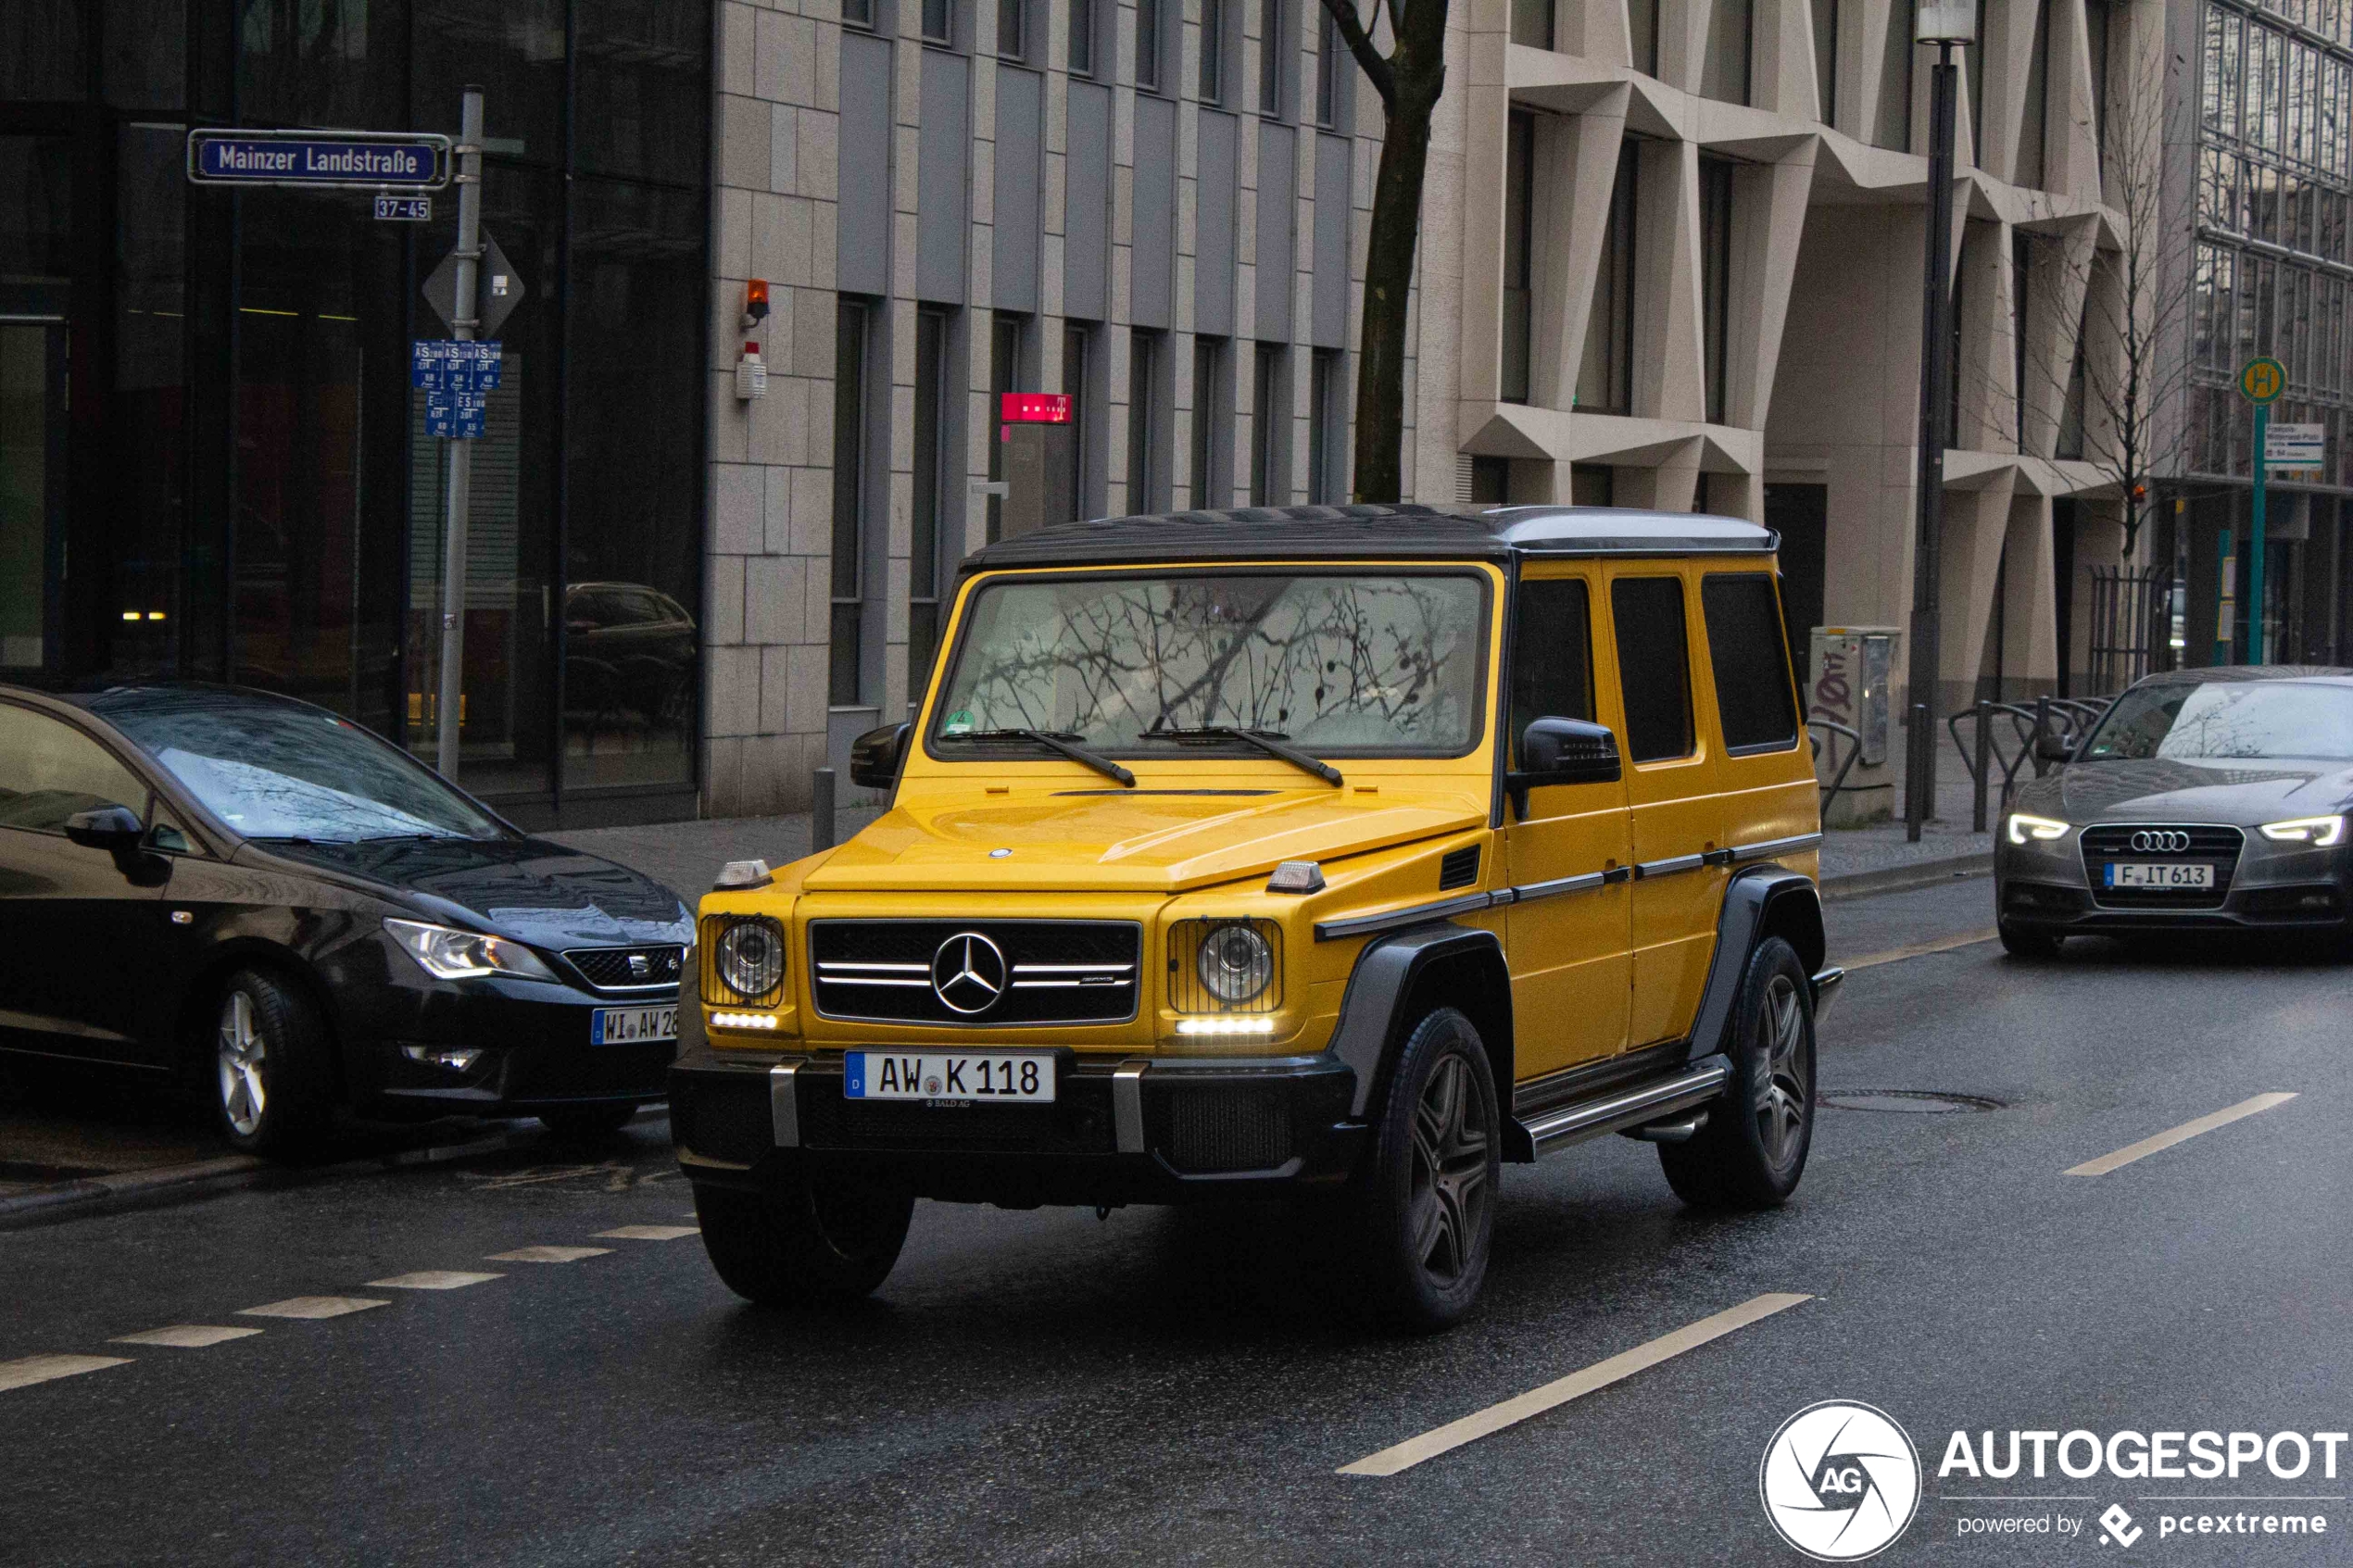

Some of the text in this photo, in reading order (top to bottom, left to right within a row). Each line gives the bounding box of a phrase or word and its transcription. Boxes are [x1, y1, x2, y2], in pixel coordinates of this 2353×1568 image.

[219, 145, 418, 173] Mainzer Landstraße
[379, 200, 427, 218] 37-45
[2121, 867, 2133, 883] F
[2146, 867, 2167, 884] IT
[2171, 867, 2205, 884] 613
[605, 1013, 625, 1040] WI
[639, 1011, 659, 1038] AW
[852, 1058, 1039, 1095] D AW K 118
[935, 1099, 971, 1108] BALD AG
